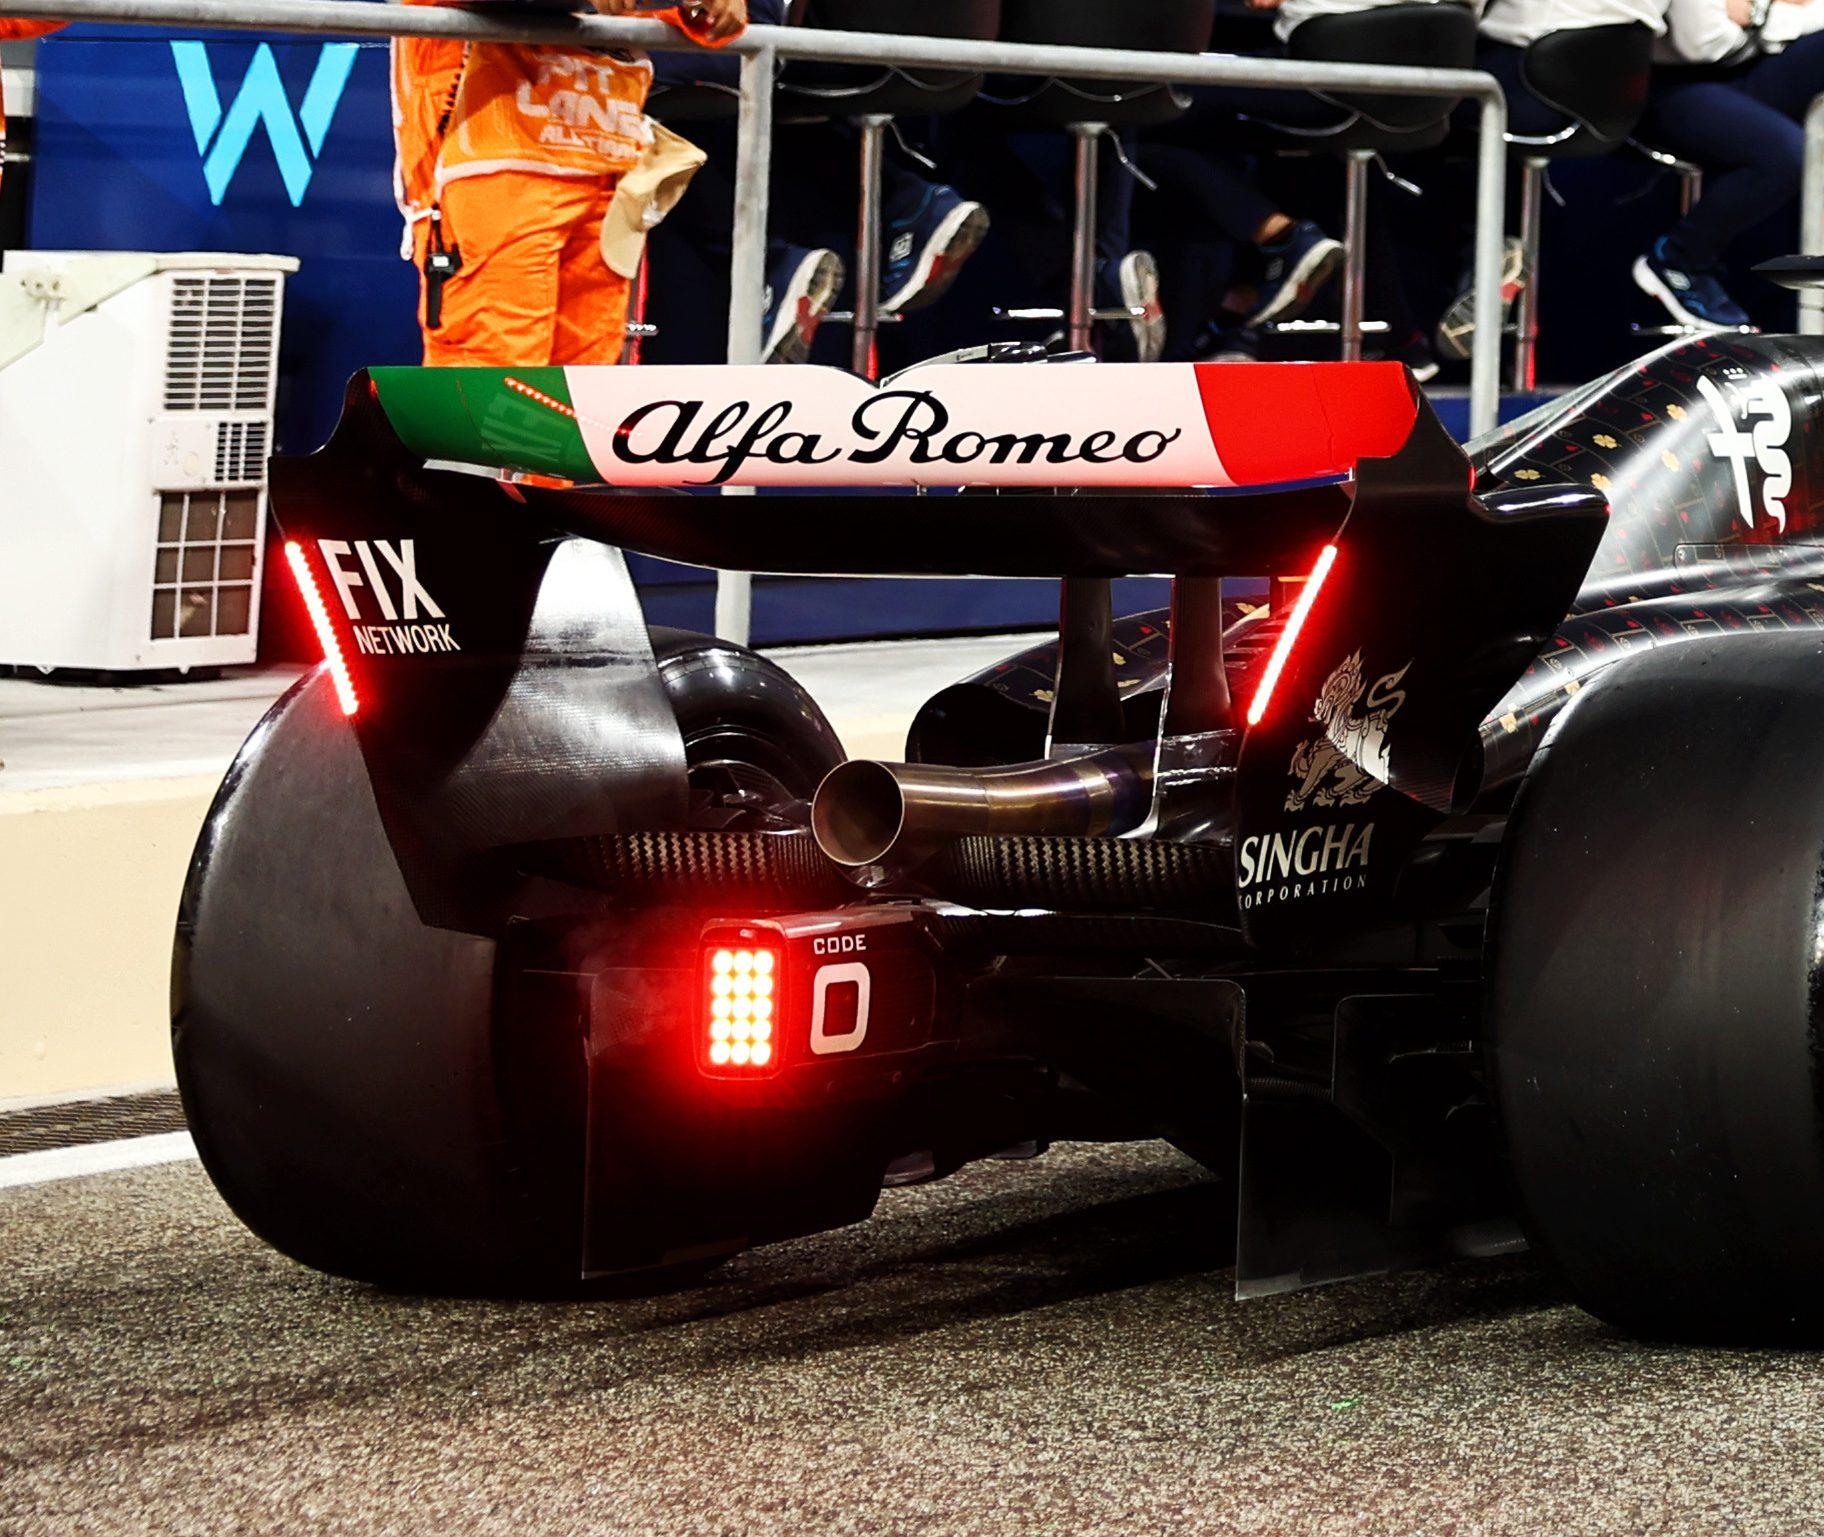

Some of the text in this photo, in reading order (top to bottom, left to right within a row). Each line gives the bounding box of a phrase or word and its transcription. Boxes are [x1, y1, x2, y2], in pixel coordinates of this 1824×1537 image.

[611, 390, 1181, 486] Alfa Romeo
[317, 539, 446, 620] FIX
[353, 624, 461, 654] NETWORK
[1238, 822, 1375, 889] SINGHA
[813, 934, 868, 956] CODE
